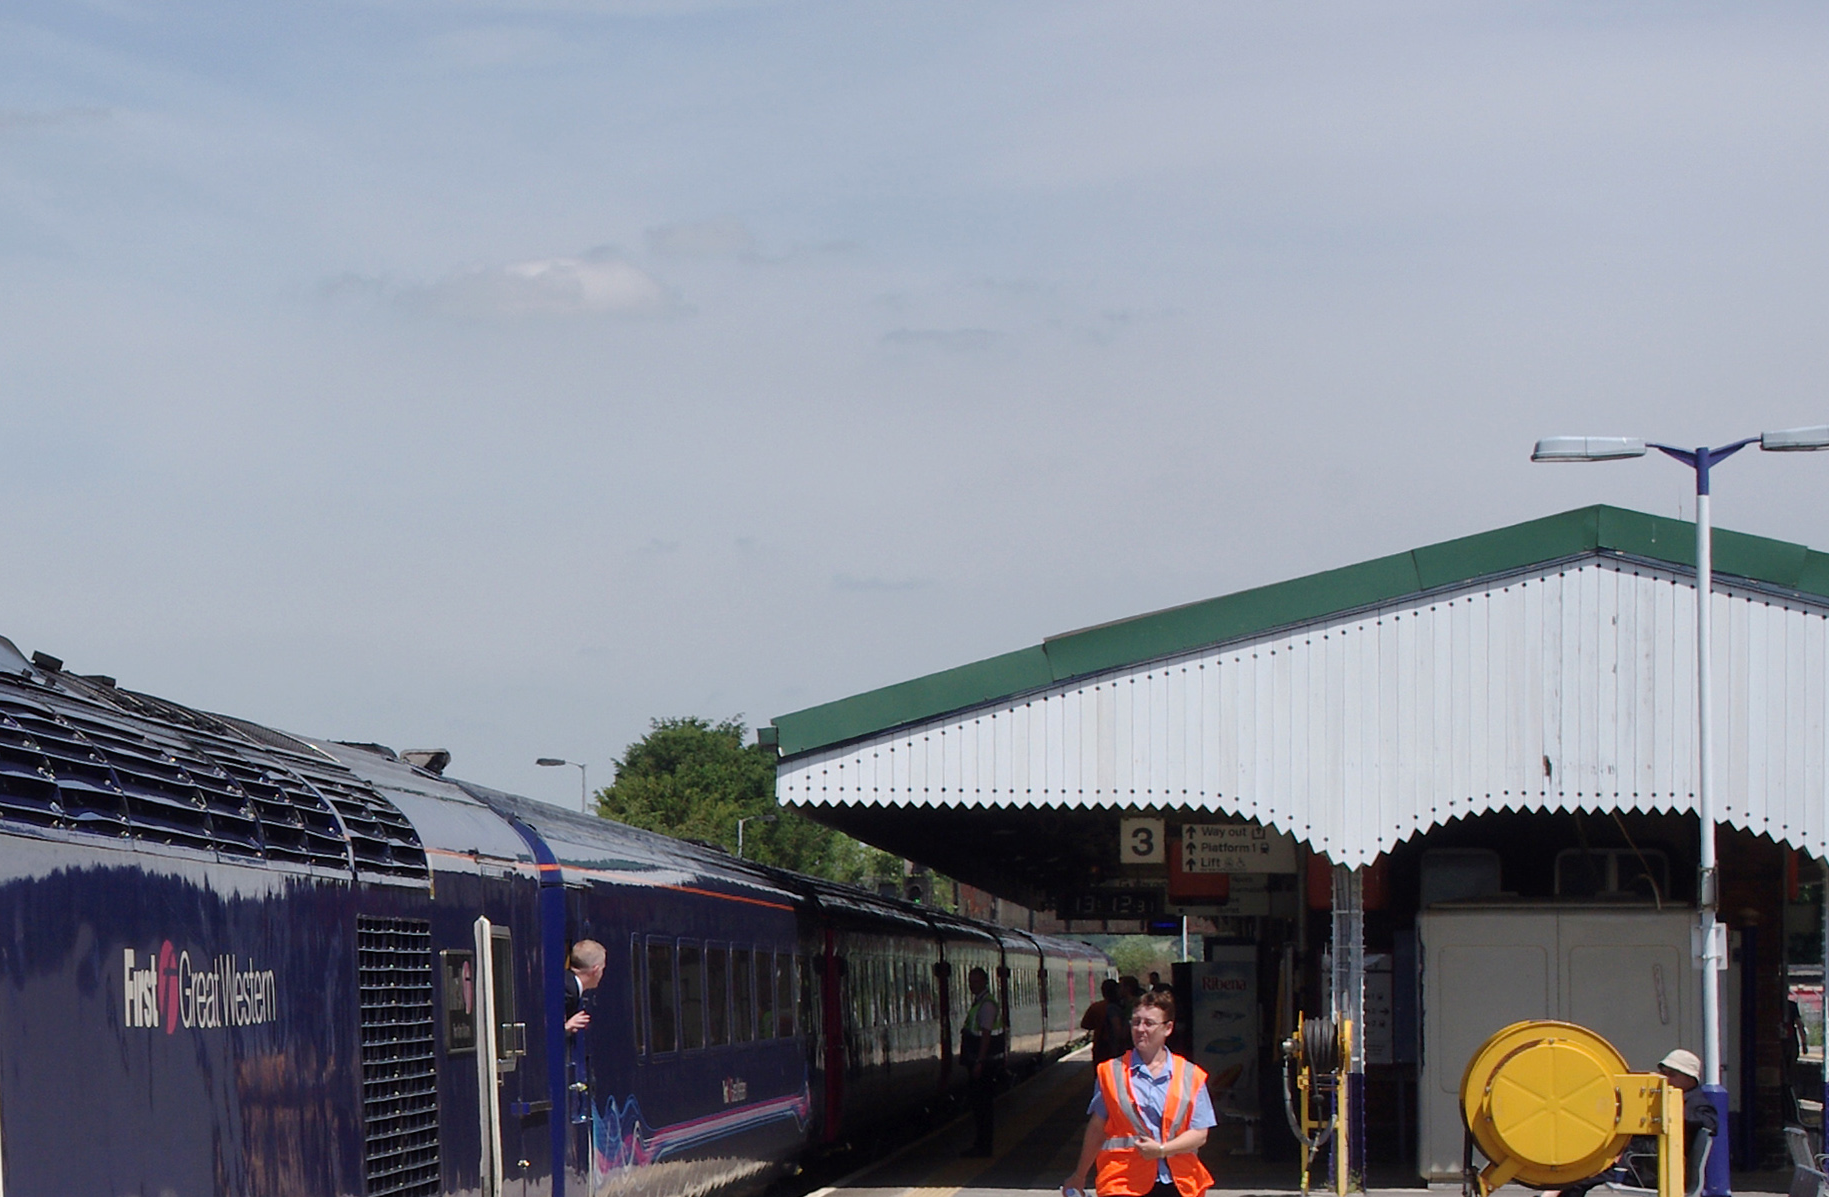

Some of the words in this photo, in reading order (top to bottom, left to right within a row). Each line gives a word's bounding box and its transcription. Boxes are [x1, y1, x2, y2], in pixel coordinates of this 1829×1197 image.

[1201, 826, 1226, 838] Way
[1228, 827, 1247, 837] out
[1131, 827, 1154, 856] 3
[1201, 842, 1250, 853] Platform
[1201, 858, 1221, 868] Lift
[124, 948, 159, 1028] First
[179, 950, 222, 1029] Great
[220, 954, 276, 1027] Western
[1202, 976, 1246, 991] Ribena
